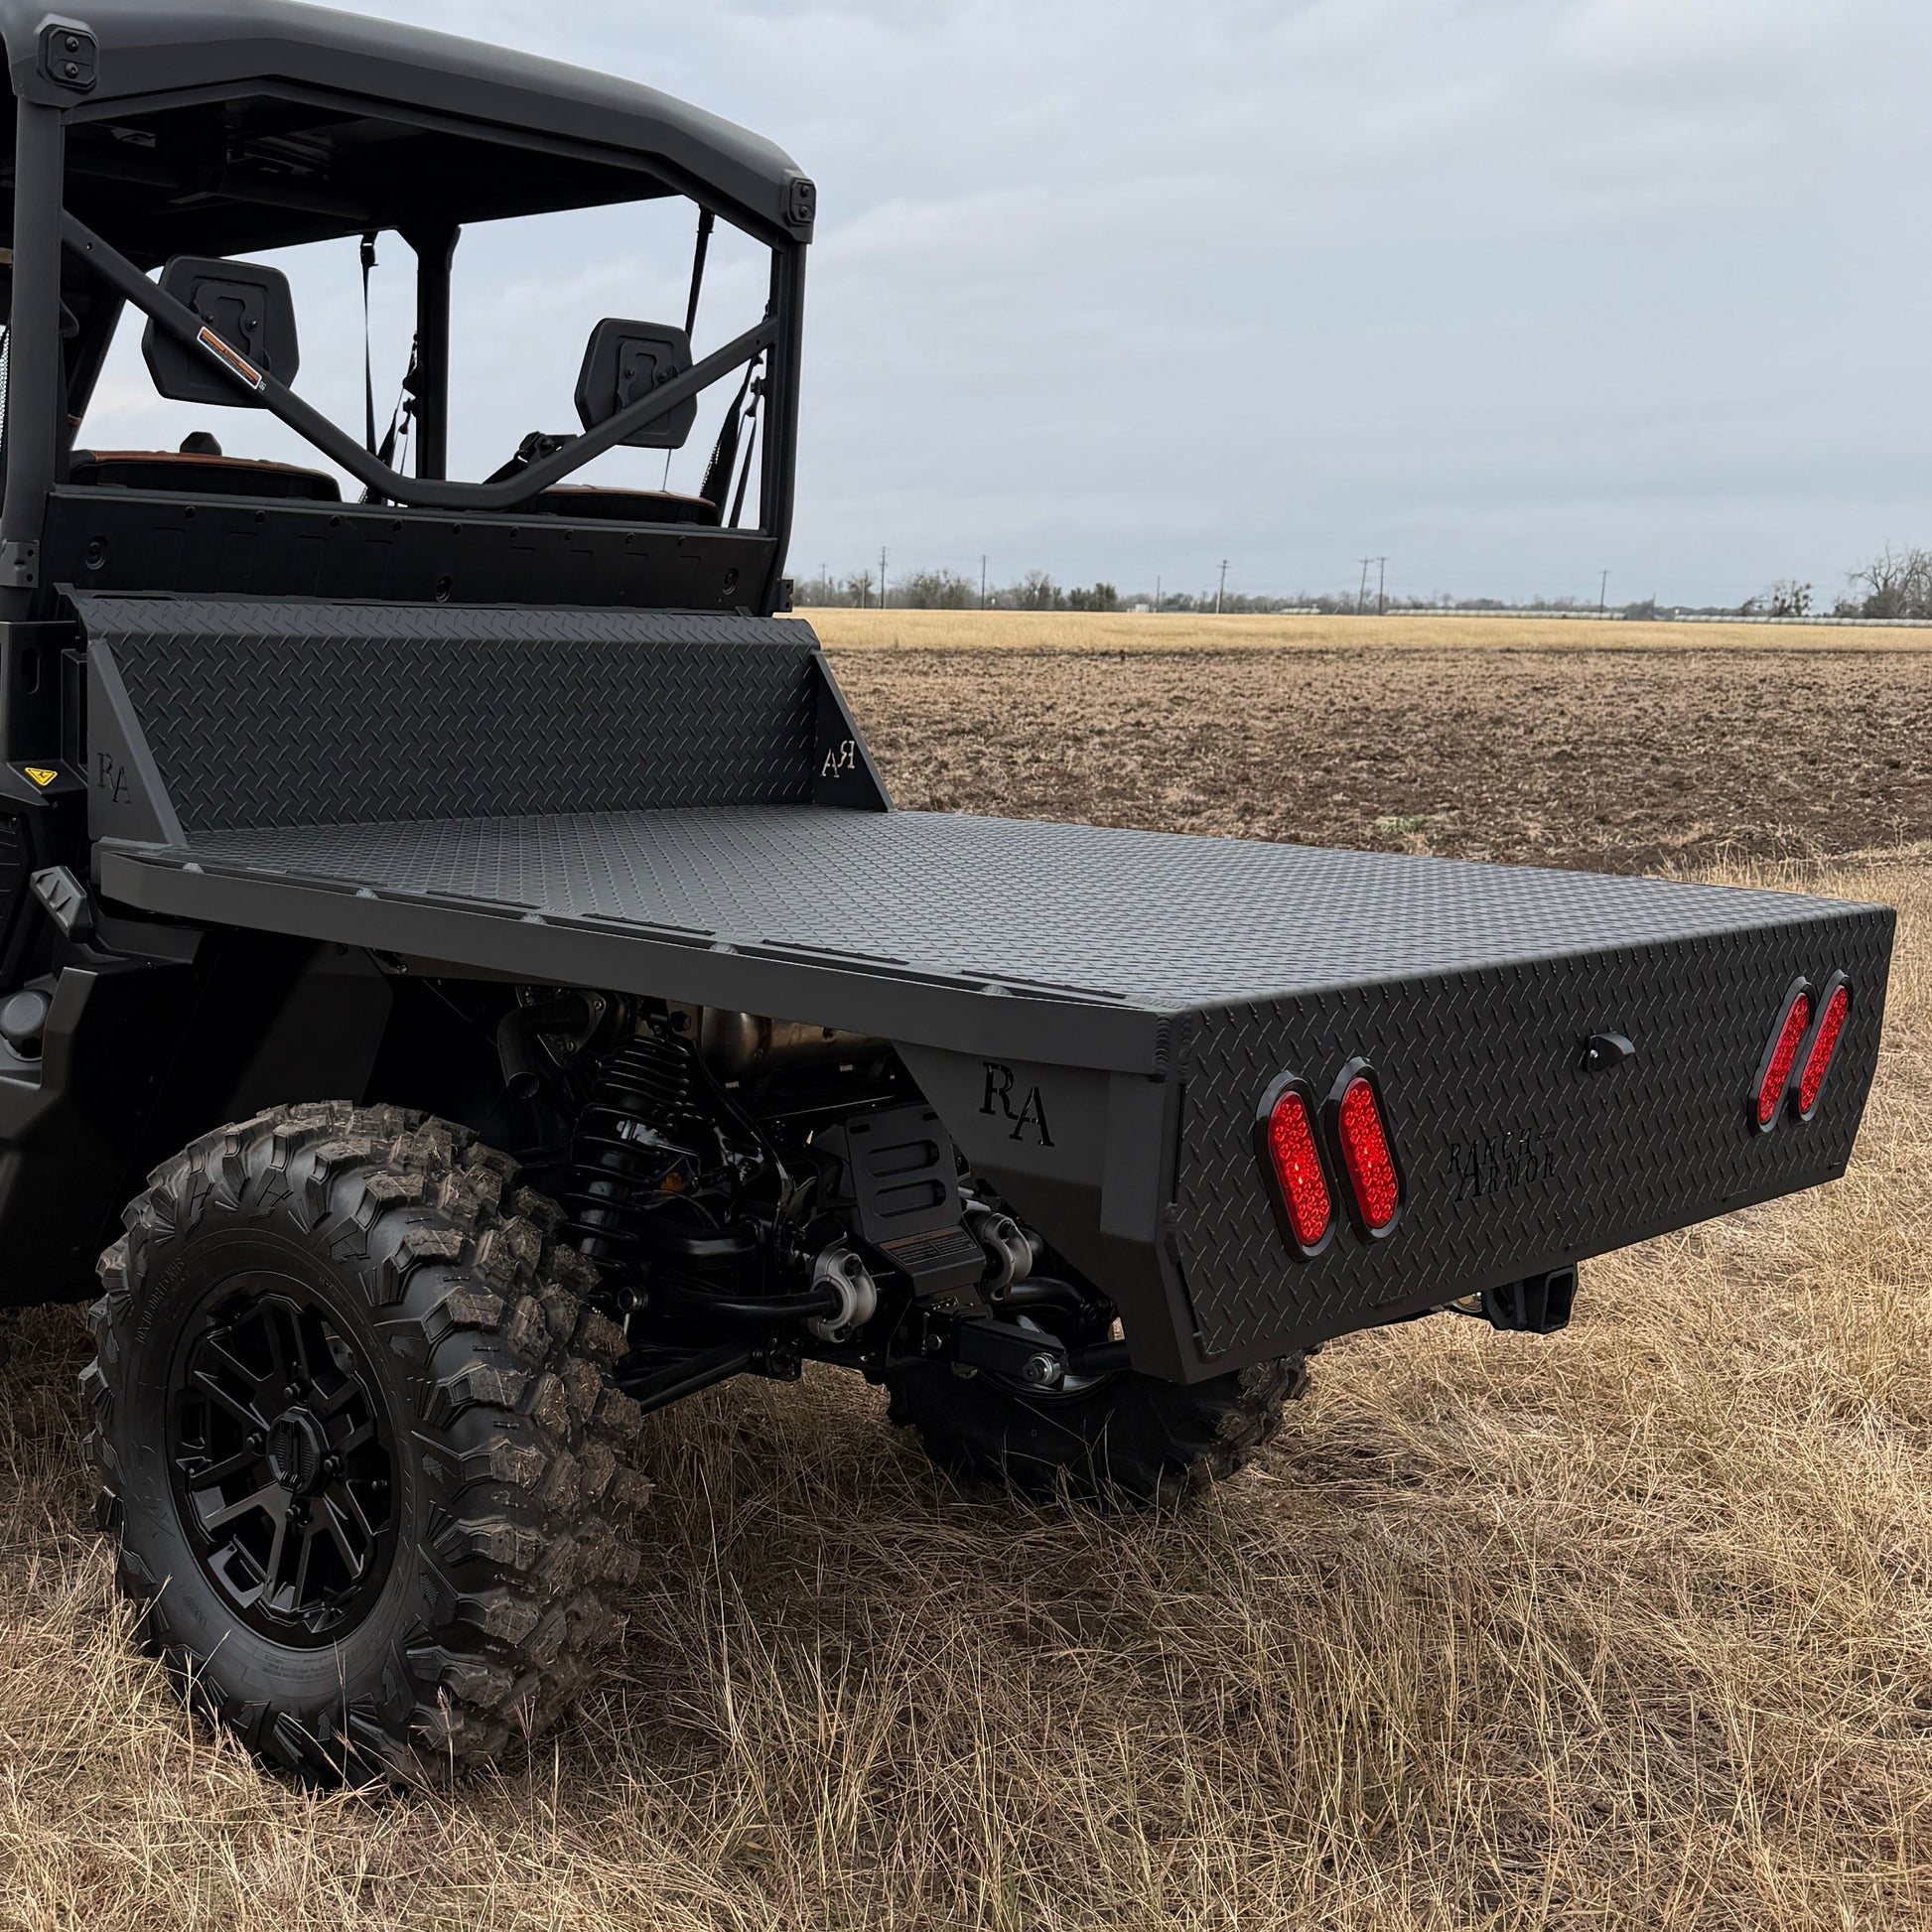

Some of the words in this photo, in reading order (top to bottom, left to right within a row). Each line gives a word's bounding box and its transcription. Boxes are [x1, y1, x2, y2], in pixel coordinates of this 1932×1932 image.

[97, 752, 132, 804] RA
[979, 1060, 1054, 1147] RA
[1448, 1127, 1533, 1187] RANCH
[1454, 1145, 1555, 1201] ARMOR
